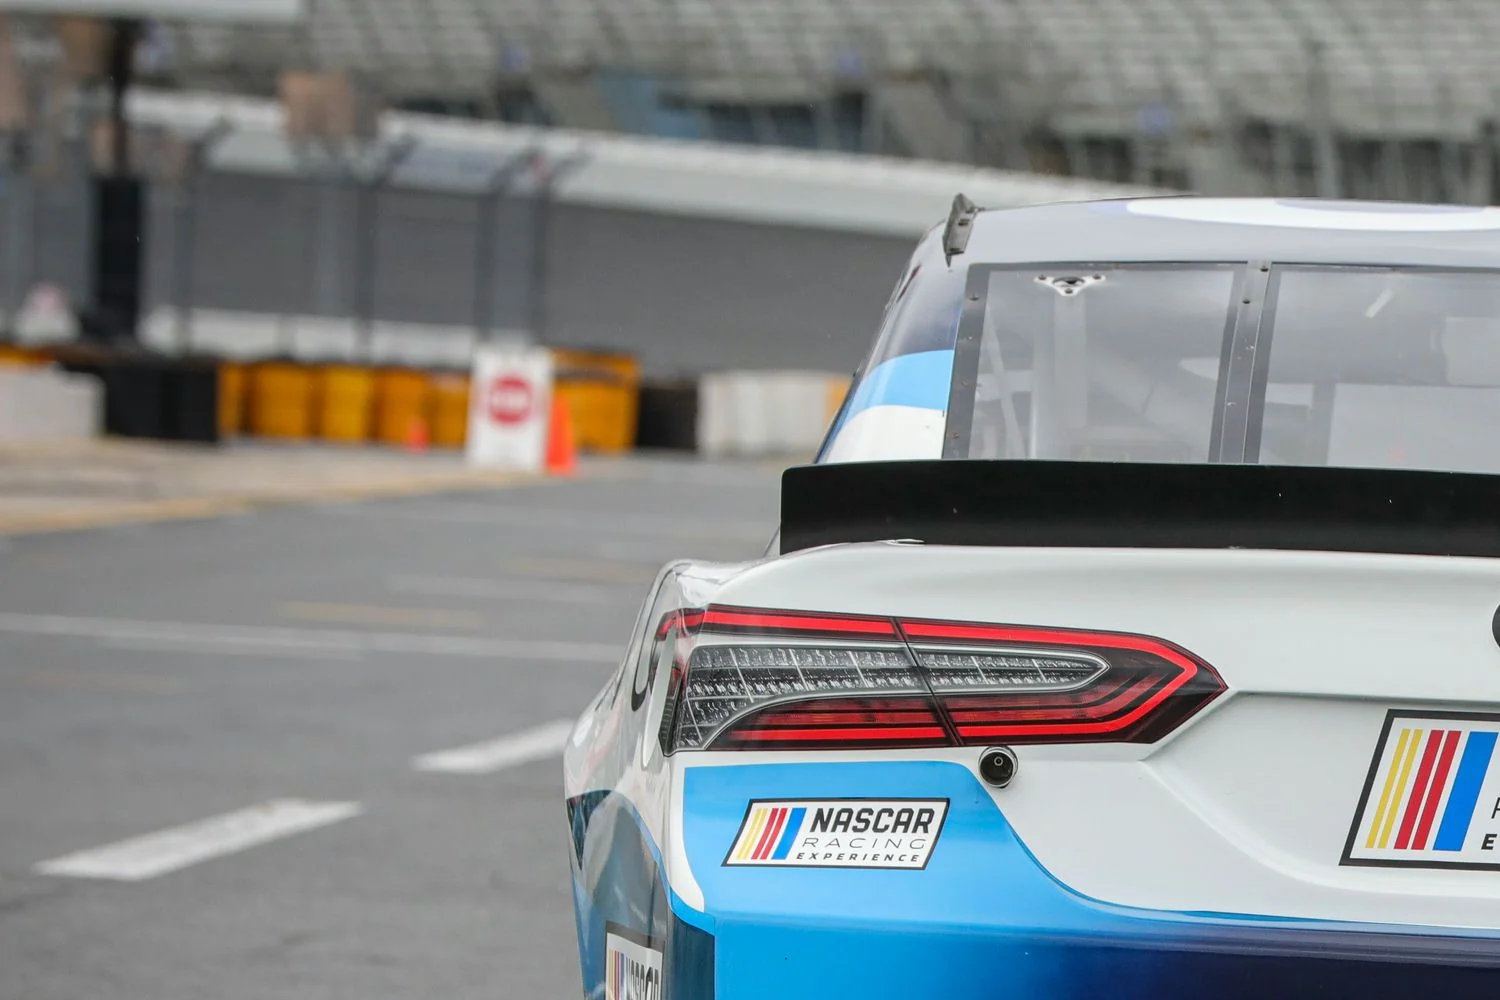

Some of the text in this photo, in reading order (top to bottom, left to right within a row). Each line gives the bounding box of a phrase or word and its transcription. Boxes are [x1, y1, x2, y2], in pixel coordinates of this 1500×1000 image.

[809, 807, 936, 834] NASCAR
[802, 837, 927, 850] RACING
[796, 852, 920, 862] EXPERIENCE
